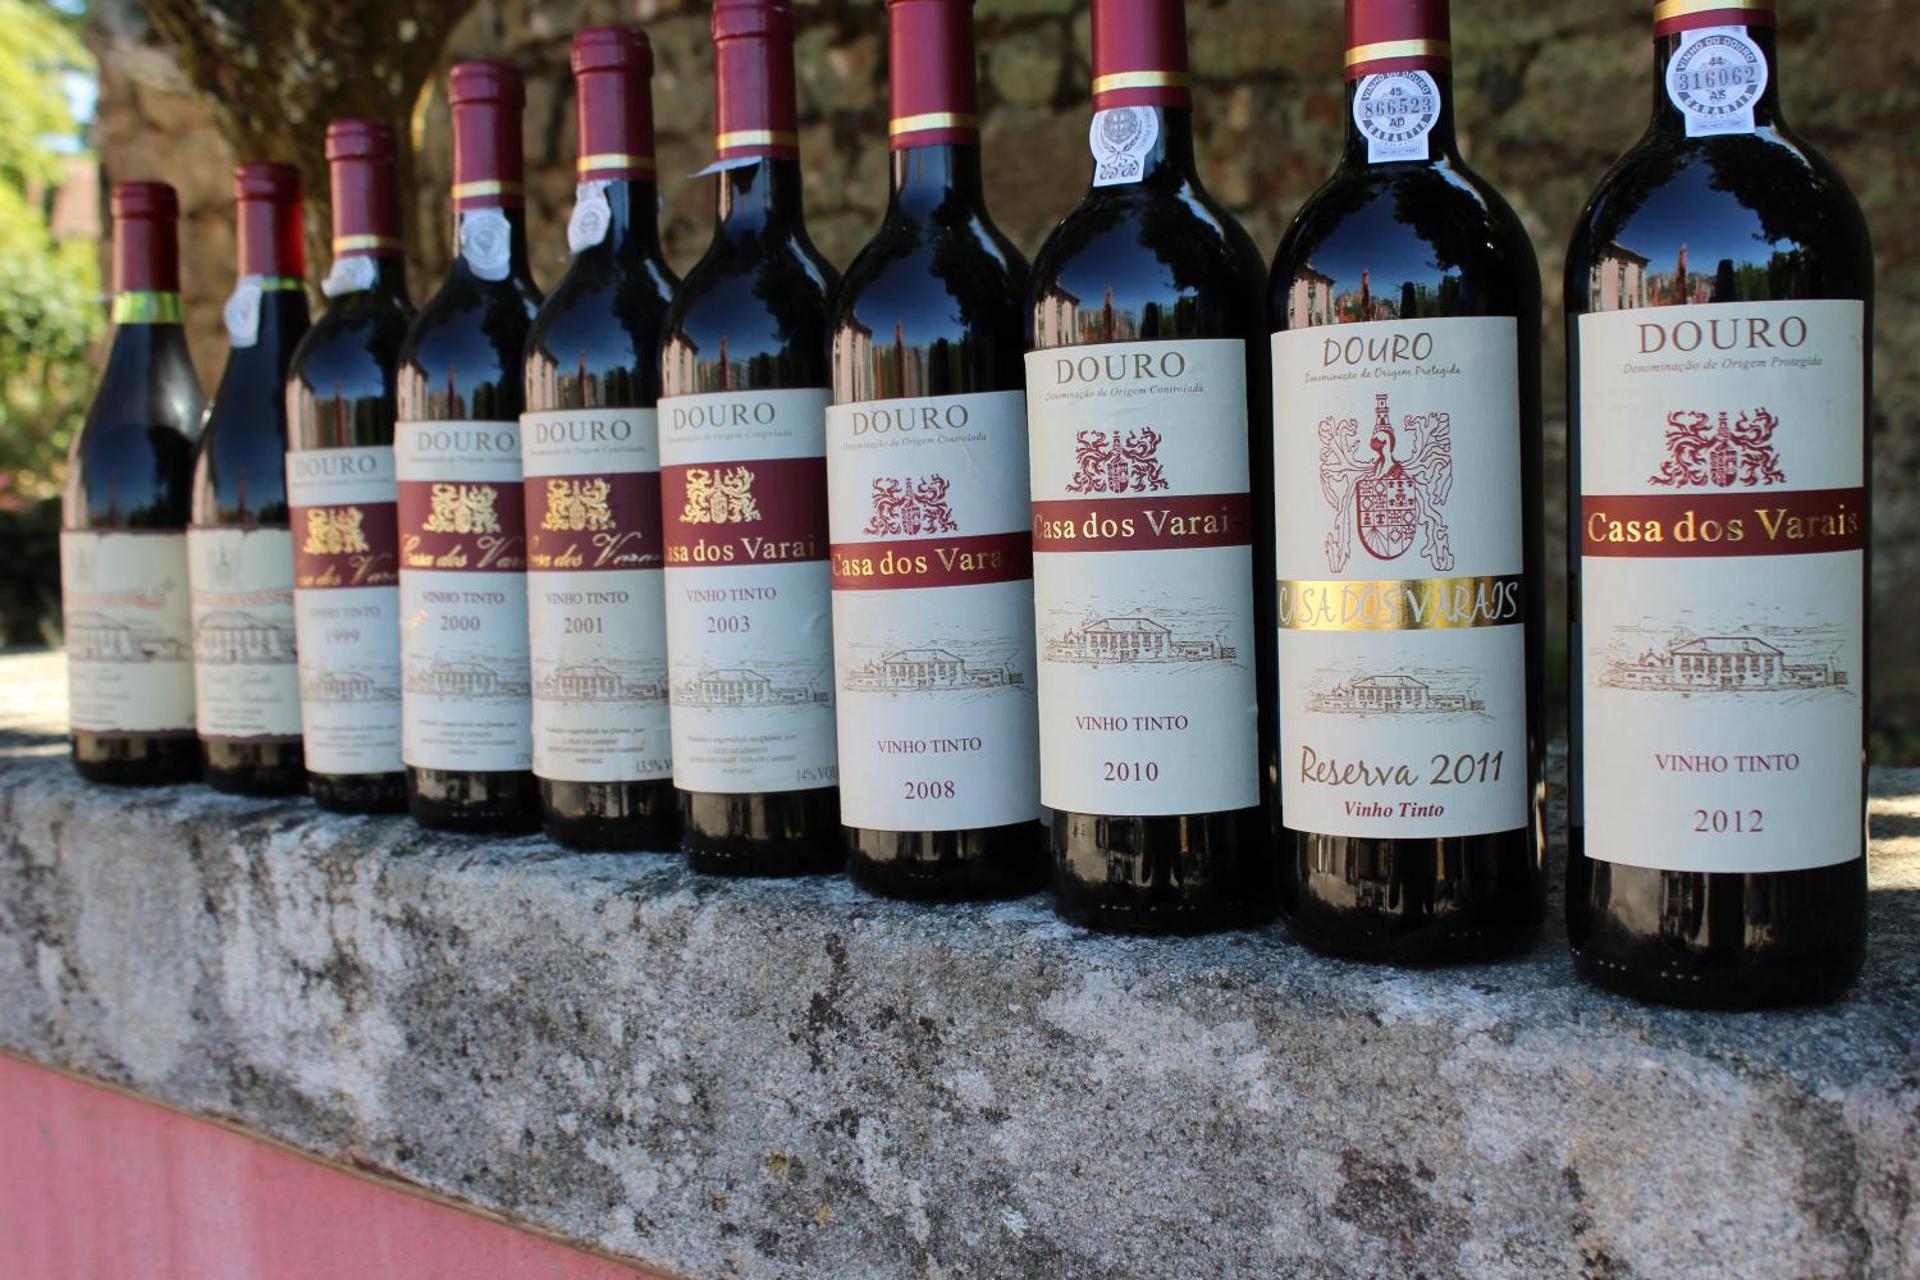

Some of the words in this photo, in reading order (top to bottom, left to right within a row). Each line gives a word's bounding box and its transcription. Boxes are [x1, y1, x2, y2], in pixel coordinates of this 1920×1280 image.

[1678, 43, 1704, 69] VINHO
[1723, 37, 1755, 64] DOURO
[1364, 96, 1432, 119] 866523
[1638, 316, 1808, 355] DOURO
[1323, 331, 1434, 368] DOURO
[1055, 350, 1186, 385] DOURO
[1360, 367, 1371, 379] de
[1374, 366, 1413, 382] Origem
[1415, 363, 1462, 380] Protegida
[1622, 360, 1700, 375] Denominação
[1703, 358, 1718, 370] de
[1721, 357, 1767, 371] Origem
[1769, 355, 1824, 370] Protegida
[1110, 385, 1147, 399] Origem
[1149, 383, 1205, 395] Controlada
[673, 401, 776, 431] DOURO
[852, 404, 969, 436] DOURO
[417, 430, 515, 453] DOURO
[535, 418, 632, 444] DOURO
[297, 454, 377, 477] DOURO
[1033, 513, 1076, 540] Casa
[1082, 511, 1135, 539] dos
[1587, 511, 1665, 543] Casa
[1673, 510, 1745, 543] dos
[1754, 503, 1858, 541] Varais
[693, 539, 735, 563] dos
[832, 553, 874, 577] Casa
[879, 550, 928, 576] dos
[462, 591, 506, 606] TINTO
[545, 592, 583, 605] VINHO
[587, 591, 629, 605] TINTO
[686, 589, 727, 602] VINHO
[729, 587, 777, 601] TINTO
[1278, 586, 1336, 626] CASA
[1340, 585, 1401, 626] DOS
[1406, 580, 1519, 623] VARAIS
[440, 615, 481, 632] 2000
[564, 616, 603, 634] 2001
[707, 615, 751, 634] 2003
[1075, 715, 1128, 732] VINHO
[1132, 714, 1189, 731] TINTO
[877, 739, 926, 754] VINHO
[930, 736, 983, 754] TINTO
[1103, 761, 1159, 782] 2010
[1300, 745, 1420, 787] Reserva
[1429, 750, 1505, 786] 2011
[1654, 754, 1729, 773] VINHO
[1734, 752, 1801, 773] TINTO
[904, 780, 956, 801] 2008
[1344, 800, 1393, 818] Vinho
[1398, 801, 1445, 818] Tinto
[1693, 808, 1765, 833] 2012
